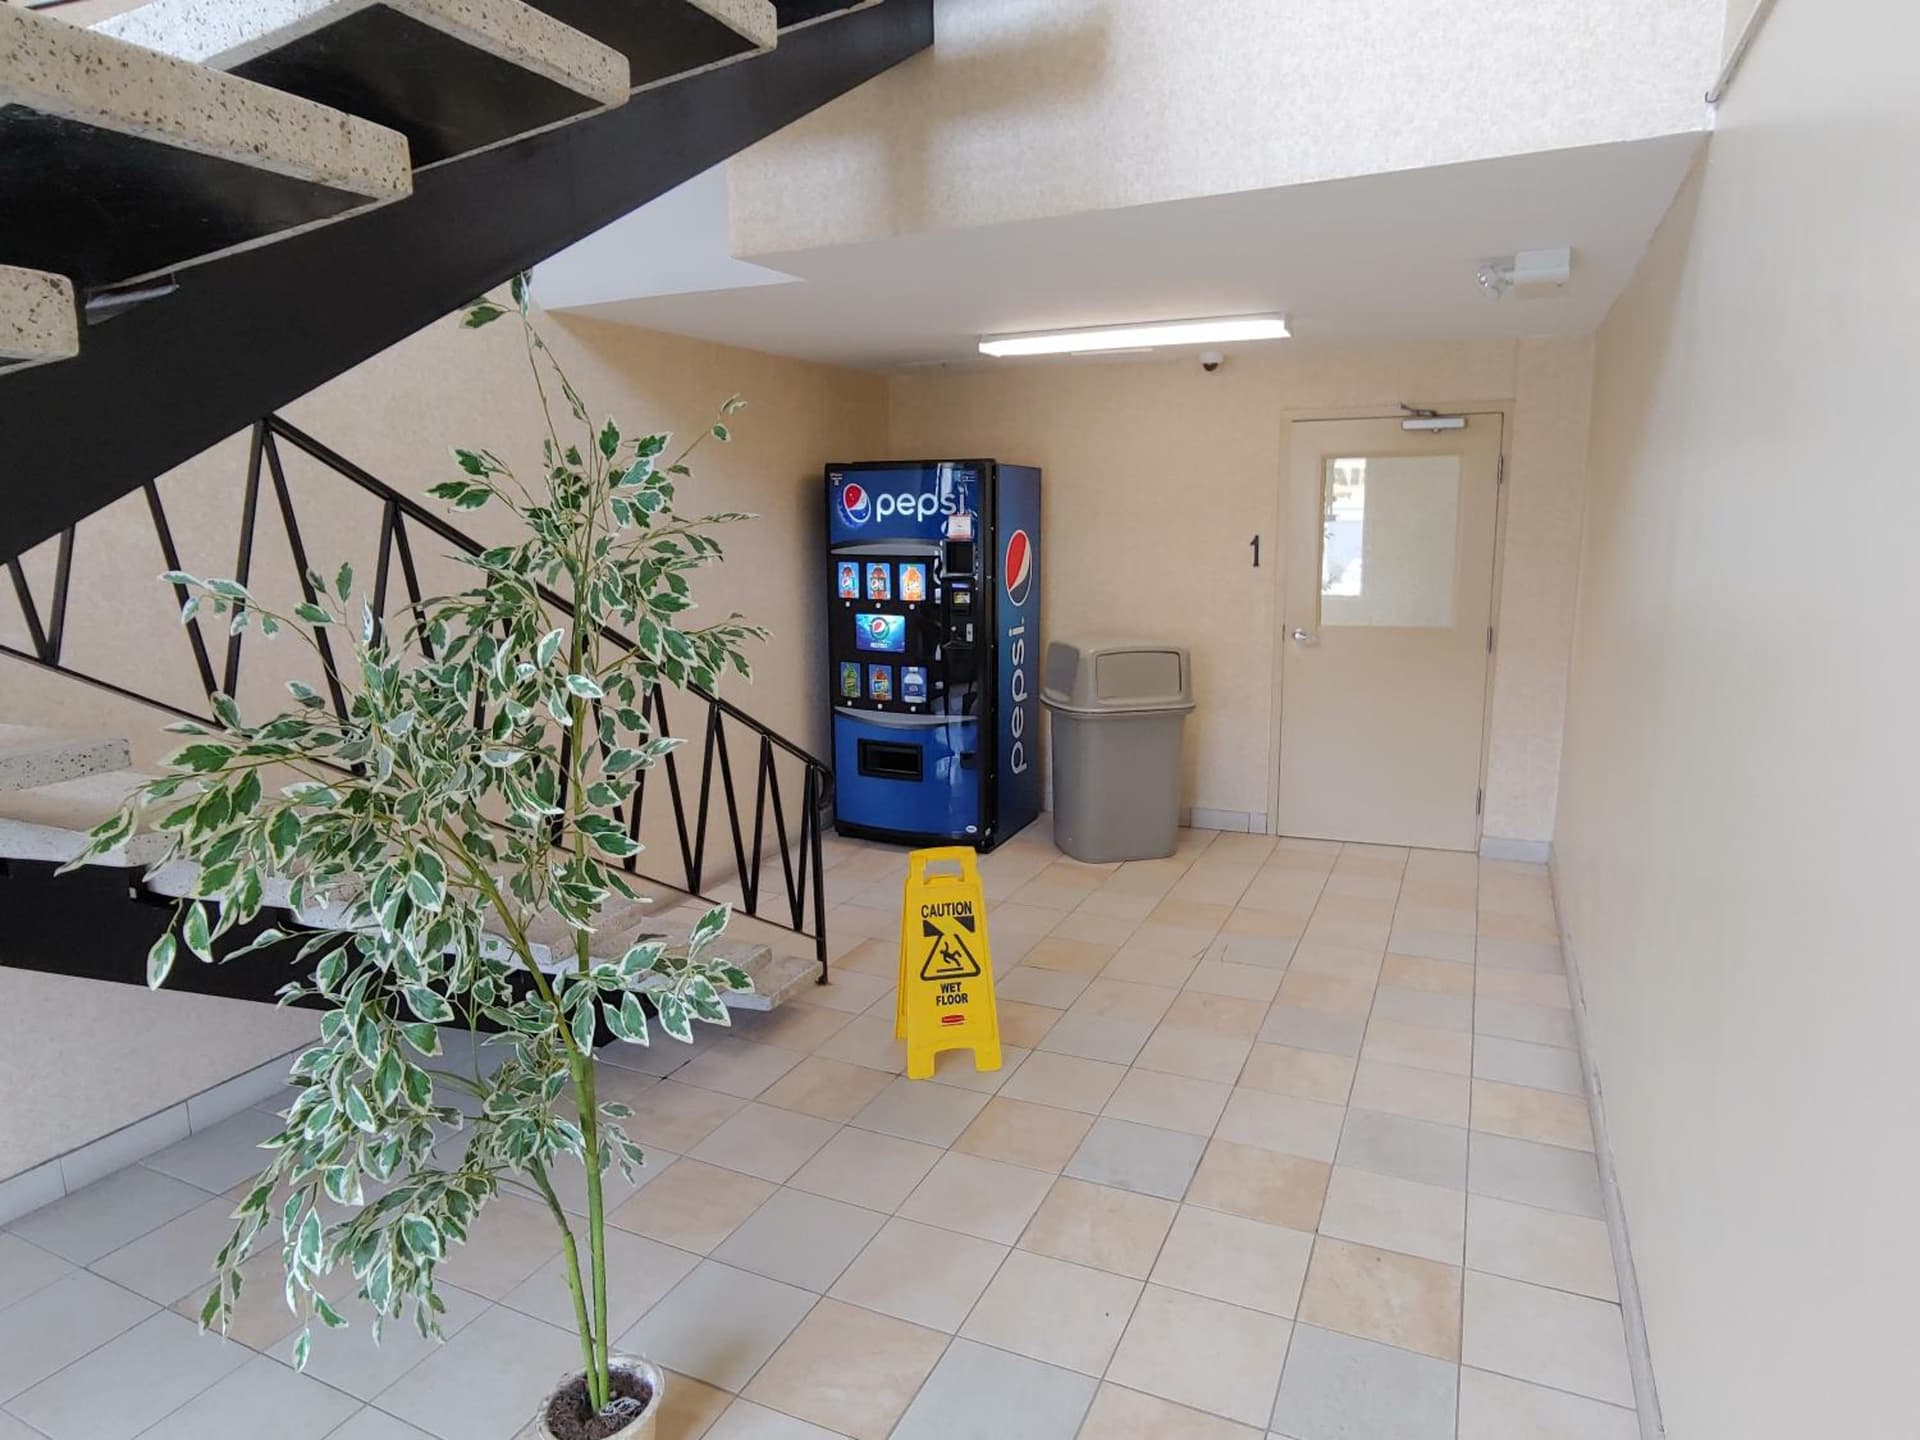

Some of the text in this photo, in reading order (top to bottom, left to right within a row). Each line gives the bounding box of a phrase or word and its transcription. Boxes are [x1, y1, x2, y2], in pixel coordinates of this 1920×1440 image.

[876, 488, 965, 522] pepsi
[1250, 535, 1260, 568] 1
[921, 901, 972, 918] CAUTION
[940, 982, 962, 994] WET
[936, 993, 968, 1006] FLOOR
